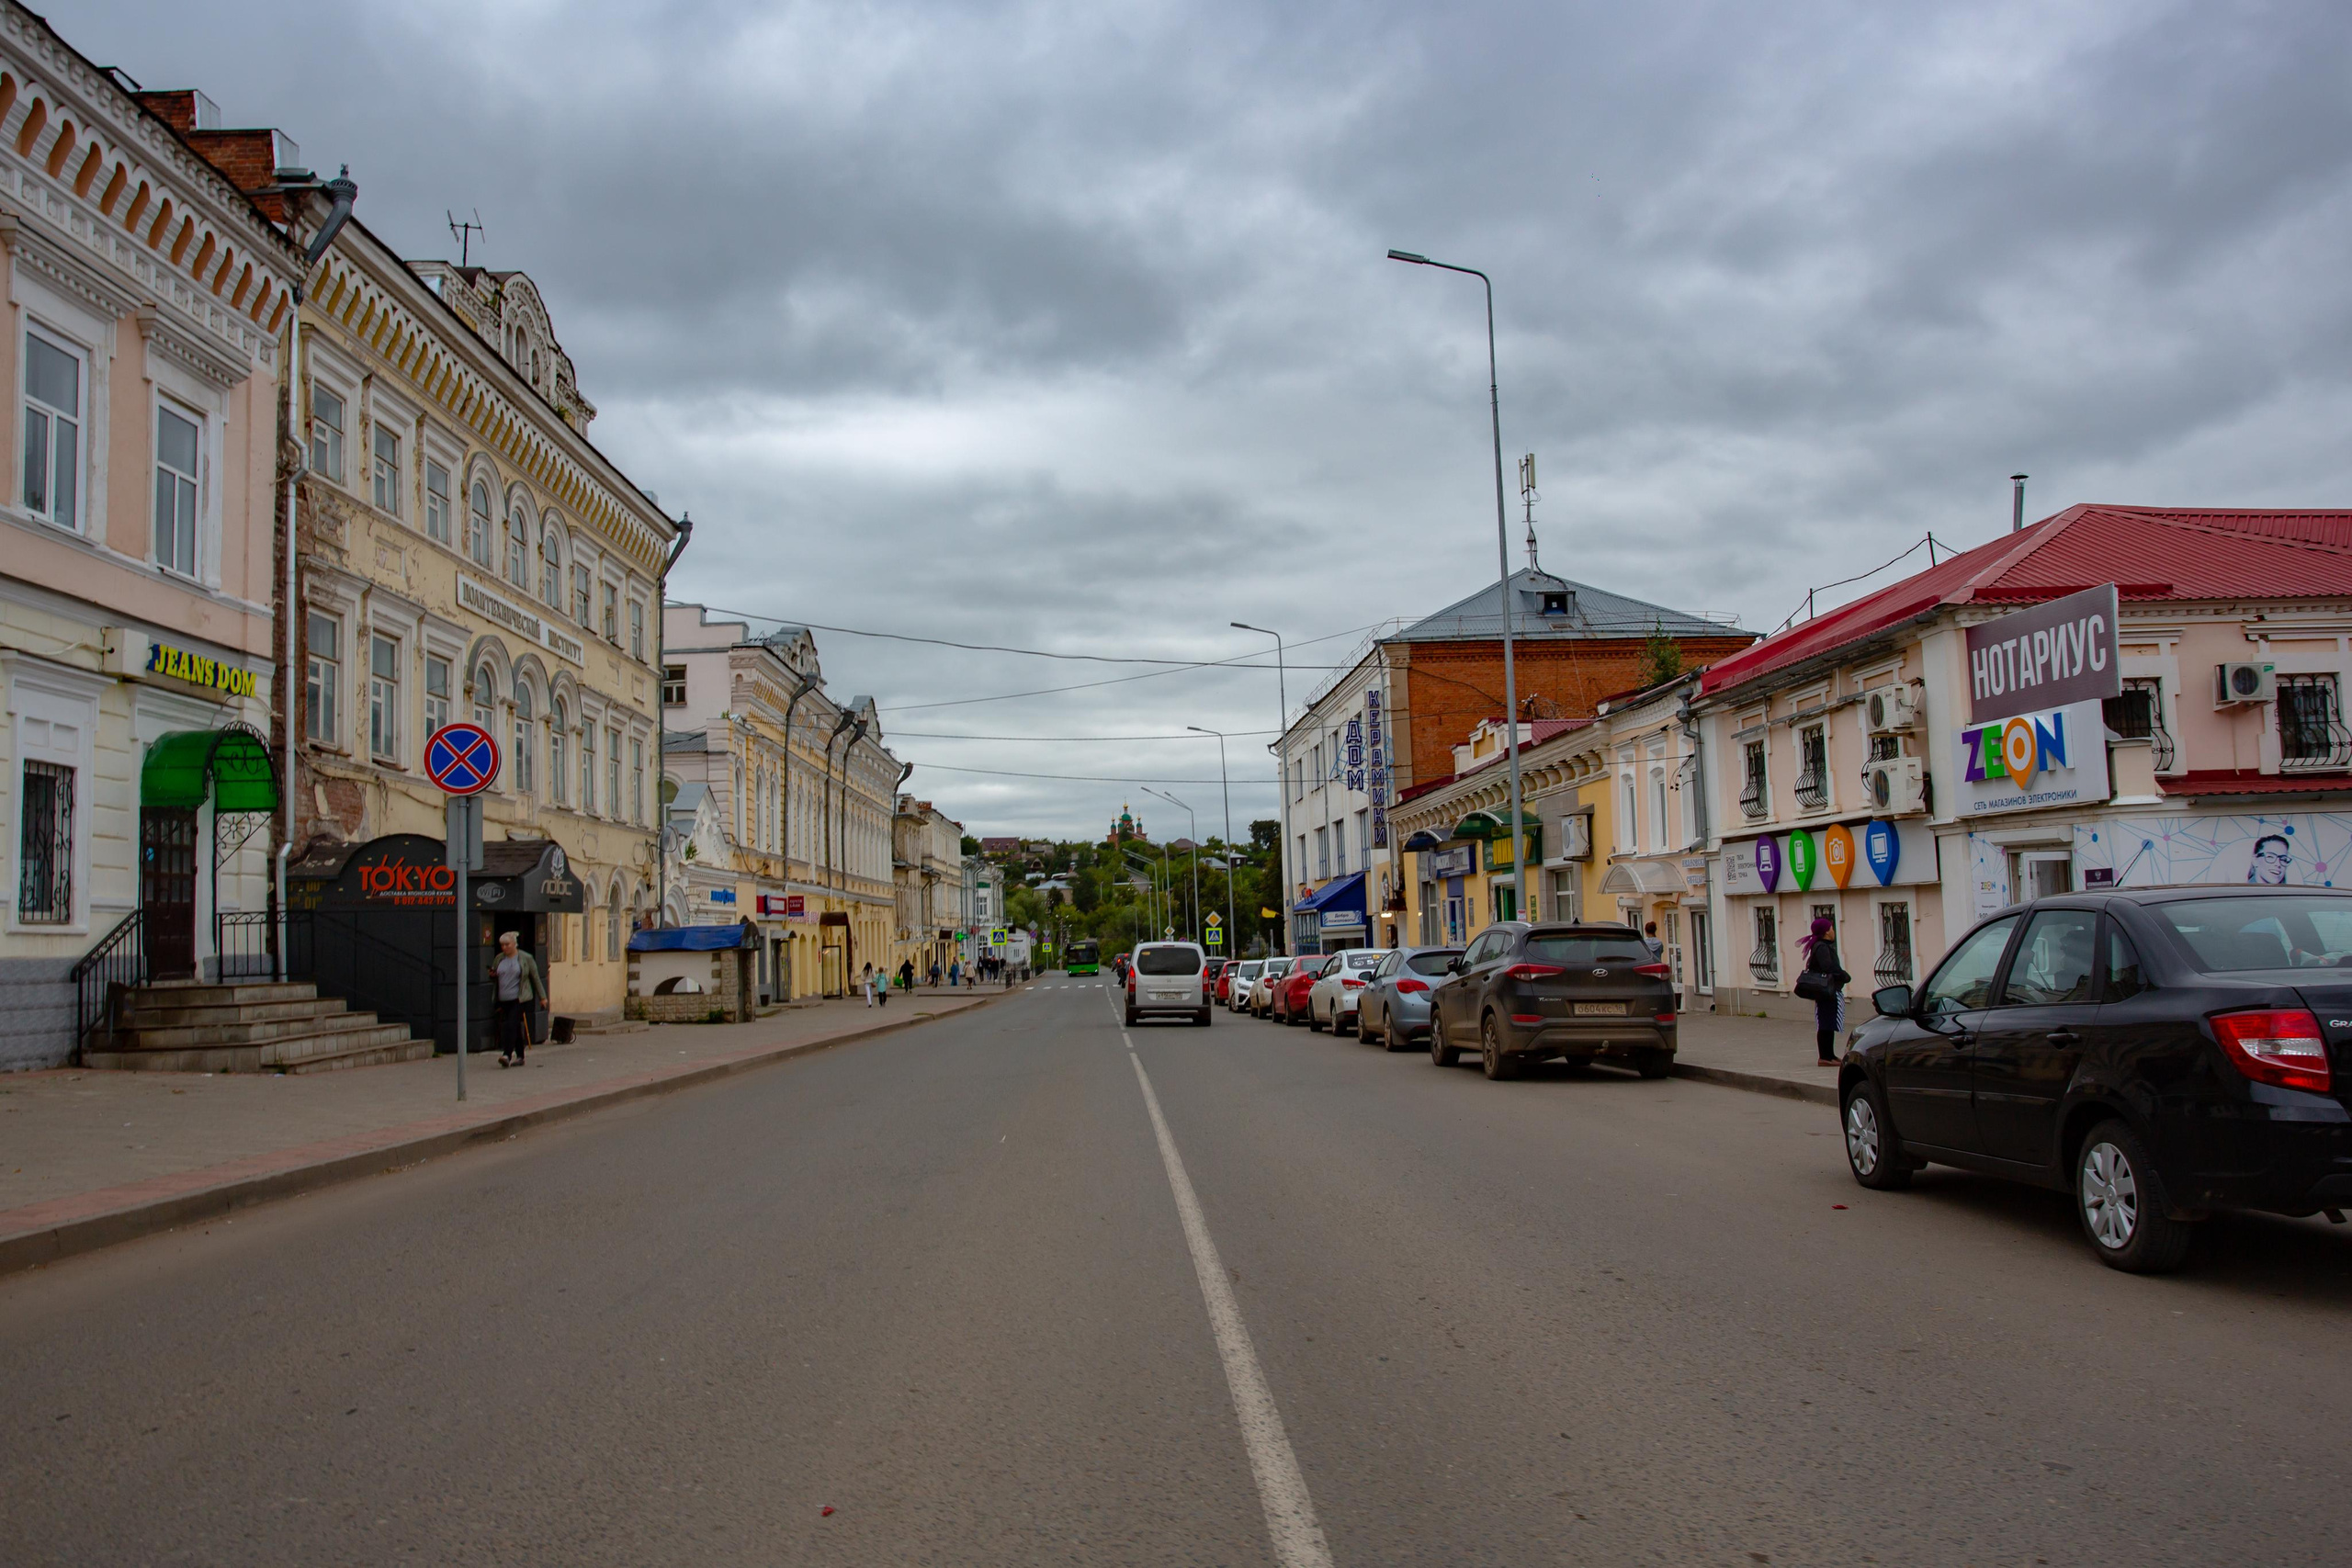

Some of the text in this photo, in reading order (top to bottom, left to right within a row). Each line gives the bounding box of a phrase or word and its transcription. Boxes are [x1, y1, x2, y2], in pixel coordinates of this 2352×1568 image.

[462, 581, 582, 661] ПОЛИТЕХНИЧЕСКИЙ ИНСТИТУТ
[1972, 614, 2107, 701] НОТАРИУС
[154, 643, 257, 698] JEANS DOM
[1346, 720, 1364, 790] ДОМ
[1368, 690, 1386, 844] КЕРАМИКИ
[1962, 712, 2069, 790] ZEON
[1973, 789, 2077, 811] СЕТЬ МАГАЗИНОВ ЭЛЕКТРОНИКИ
[358, 863, 455, 892] TOKYO
